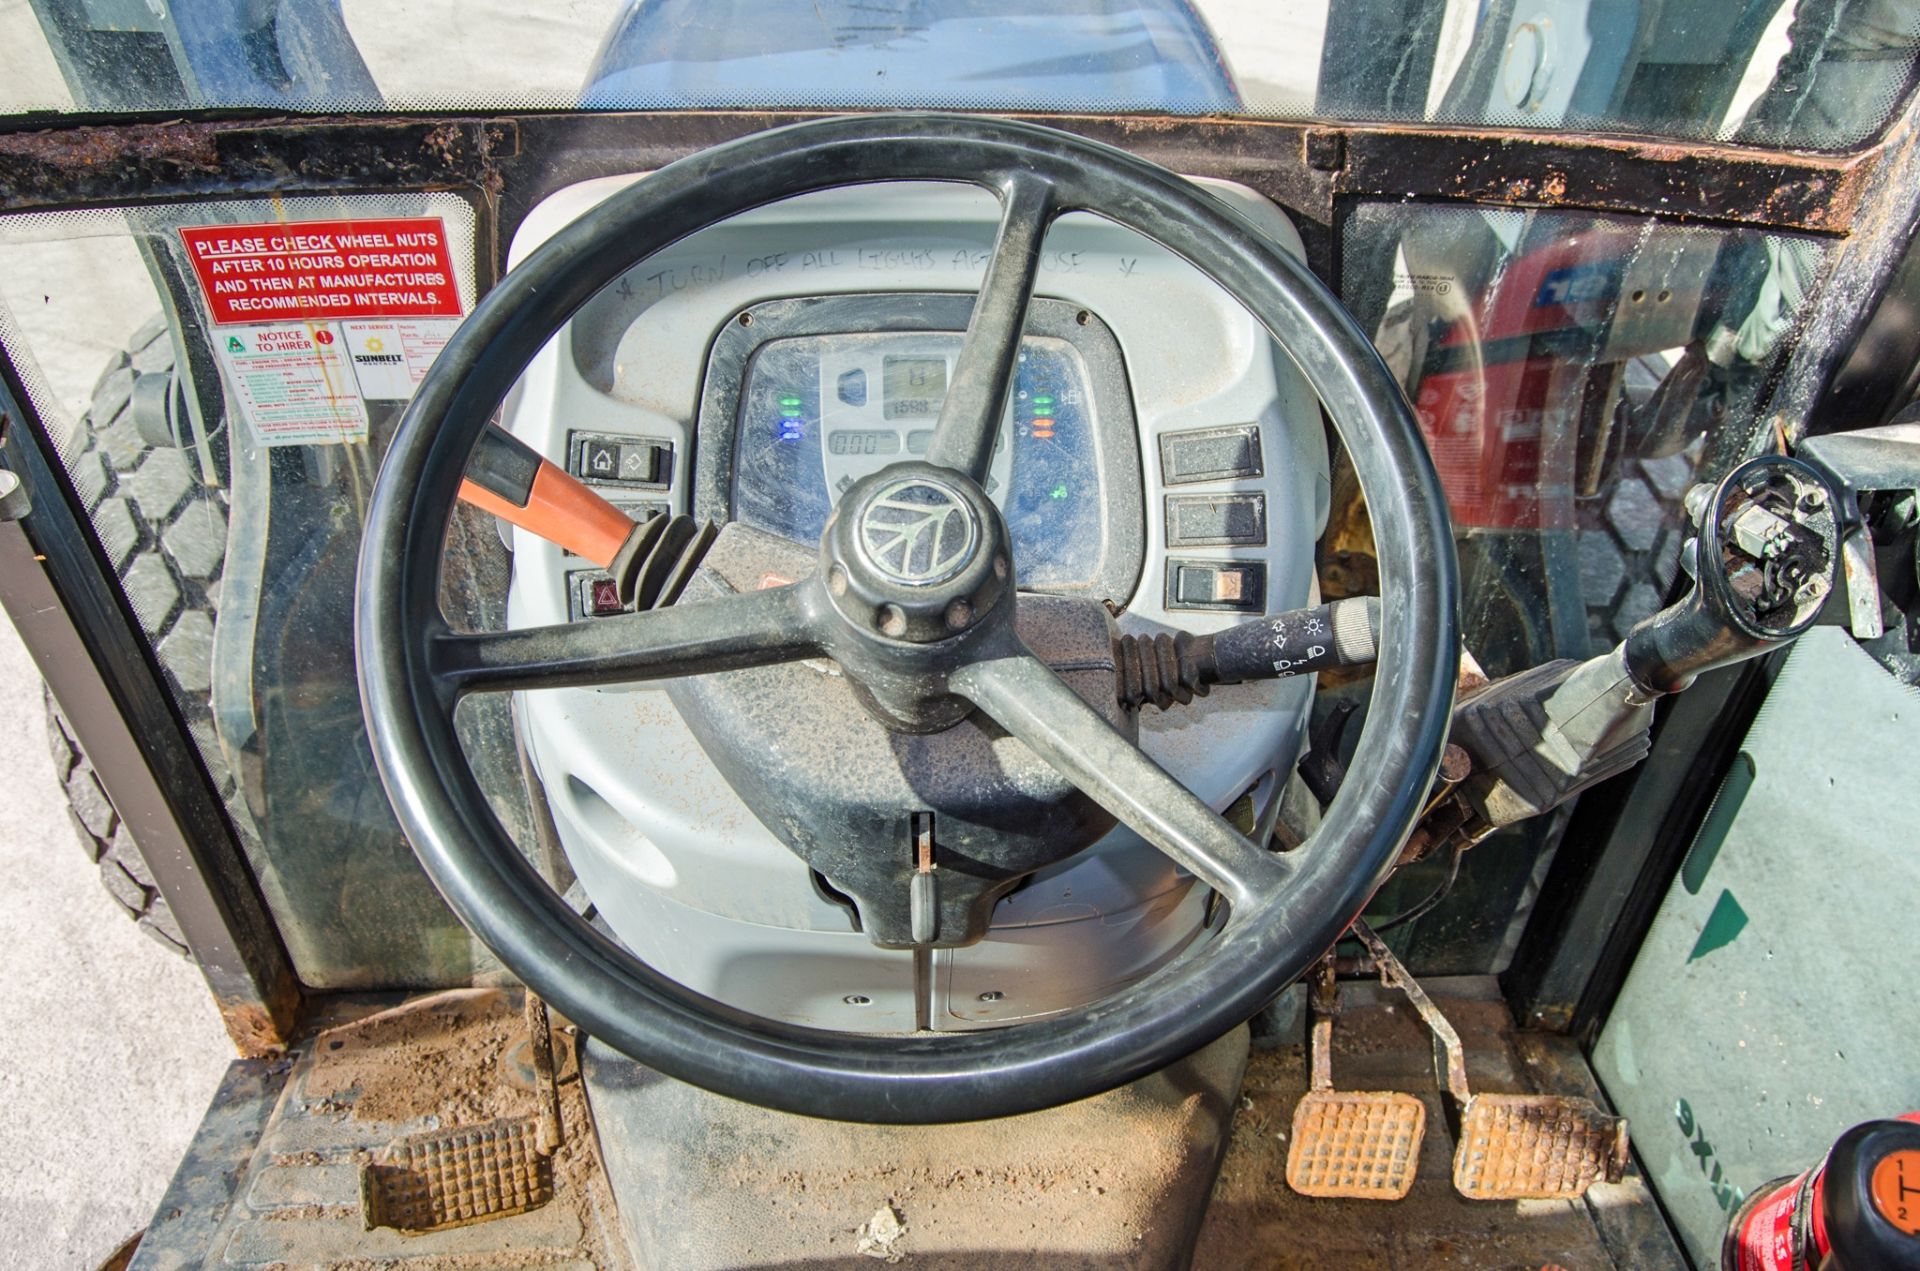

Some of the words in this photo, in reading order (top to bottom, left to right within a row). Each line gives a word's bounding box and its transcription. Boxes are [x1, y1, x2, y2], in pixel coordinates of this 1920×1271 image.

[195, 237, 267, 255] PLEASE
[271, 235, 335, 251] CHECK
[336, 234, 394, 248] WHEEL
[396, 233, 438, 247] NUTS
[212, 259, 265, 274] AFTER
[267, 258, 285, 271] 10
[288, 255, 345, 270] HOURS
[348, 253, 437, 267] OPERATION
[746, 251, 788, 277] OFF
[801, 250, 843, 271] ALL
[215, 279, 248, 294] AND
[250, 276, 294, 291] THEN
[298, 276, 316, 289] AT
[319, 272, 446, 288] MANUFACTURES
[228, 294, 351, 312] RECOMMENDED
[354, 292, 442, 306] INTERVALS.
[257, 330, 304, 342] NOTICE
[255, 343, 273, 352] TO
[277, 340, 312, 351] HIRER
[354, 354, 402, 362] SUNBELT
[1896, 1158, 1903, 1172] 1
[1897, 1207, 1907, 1220] 2
